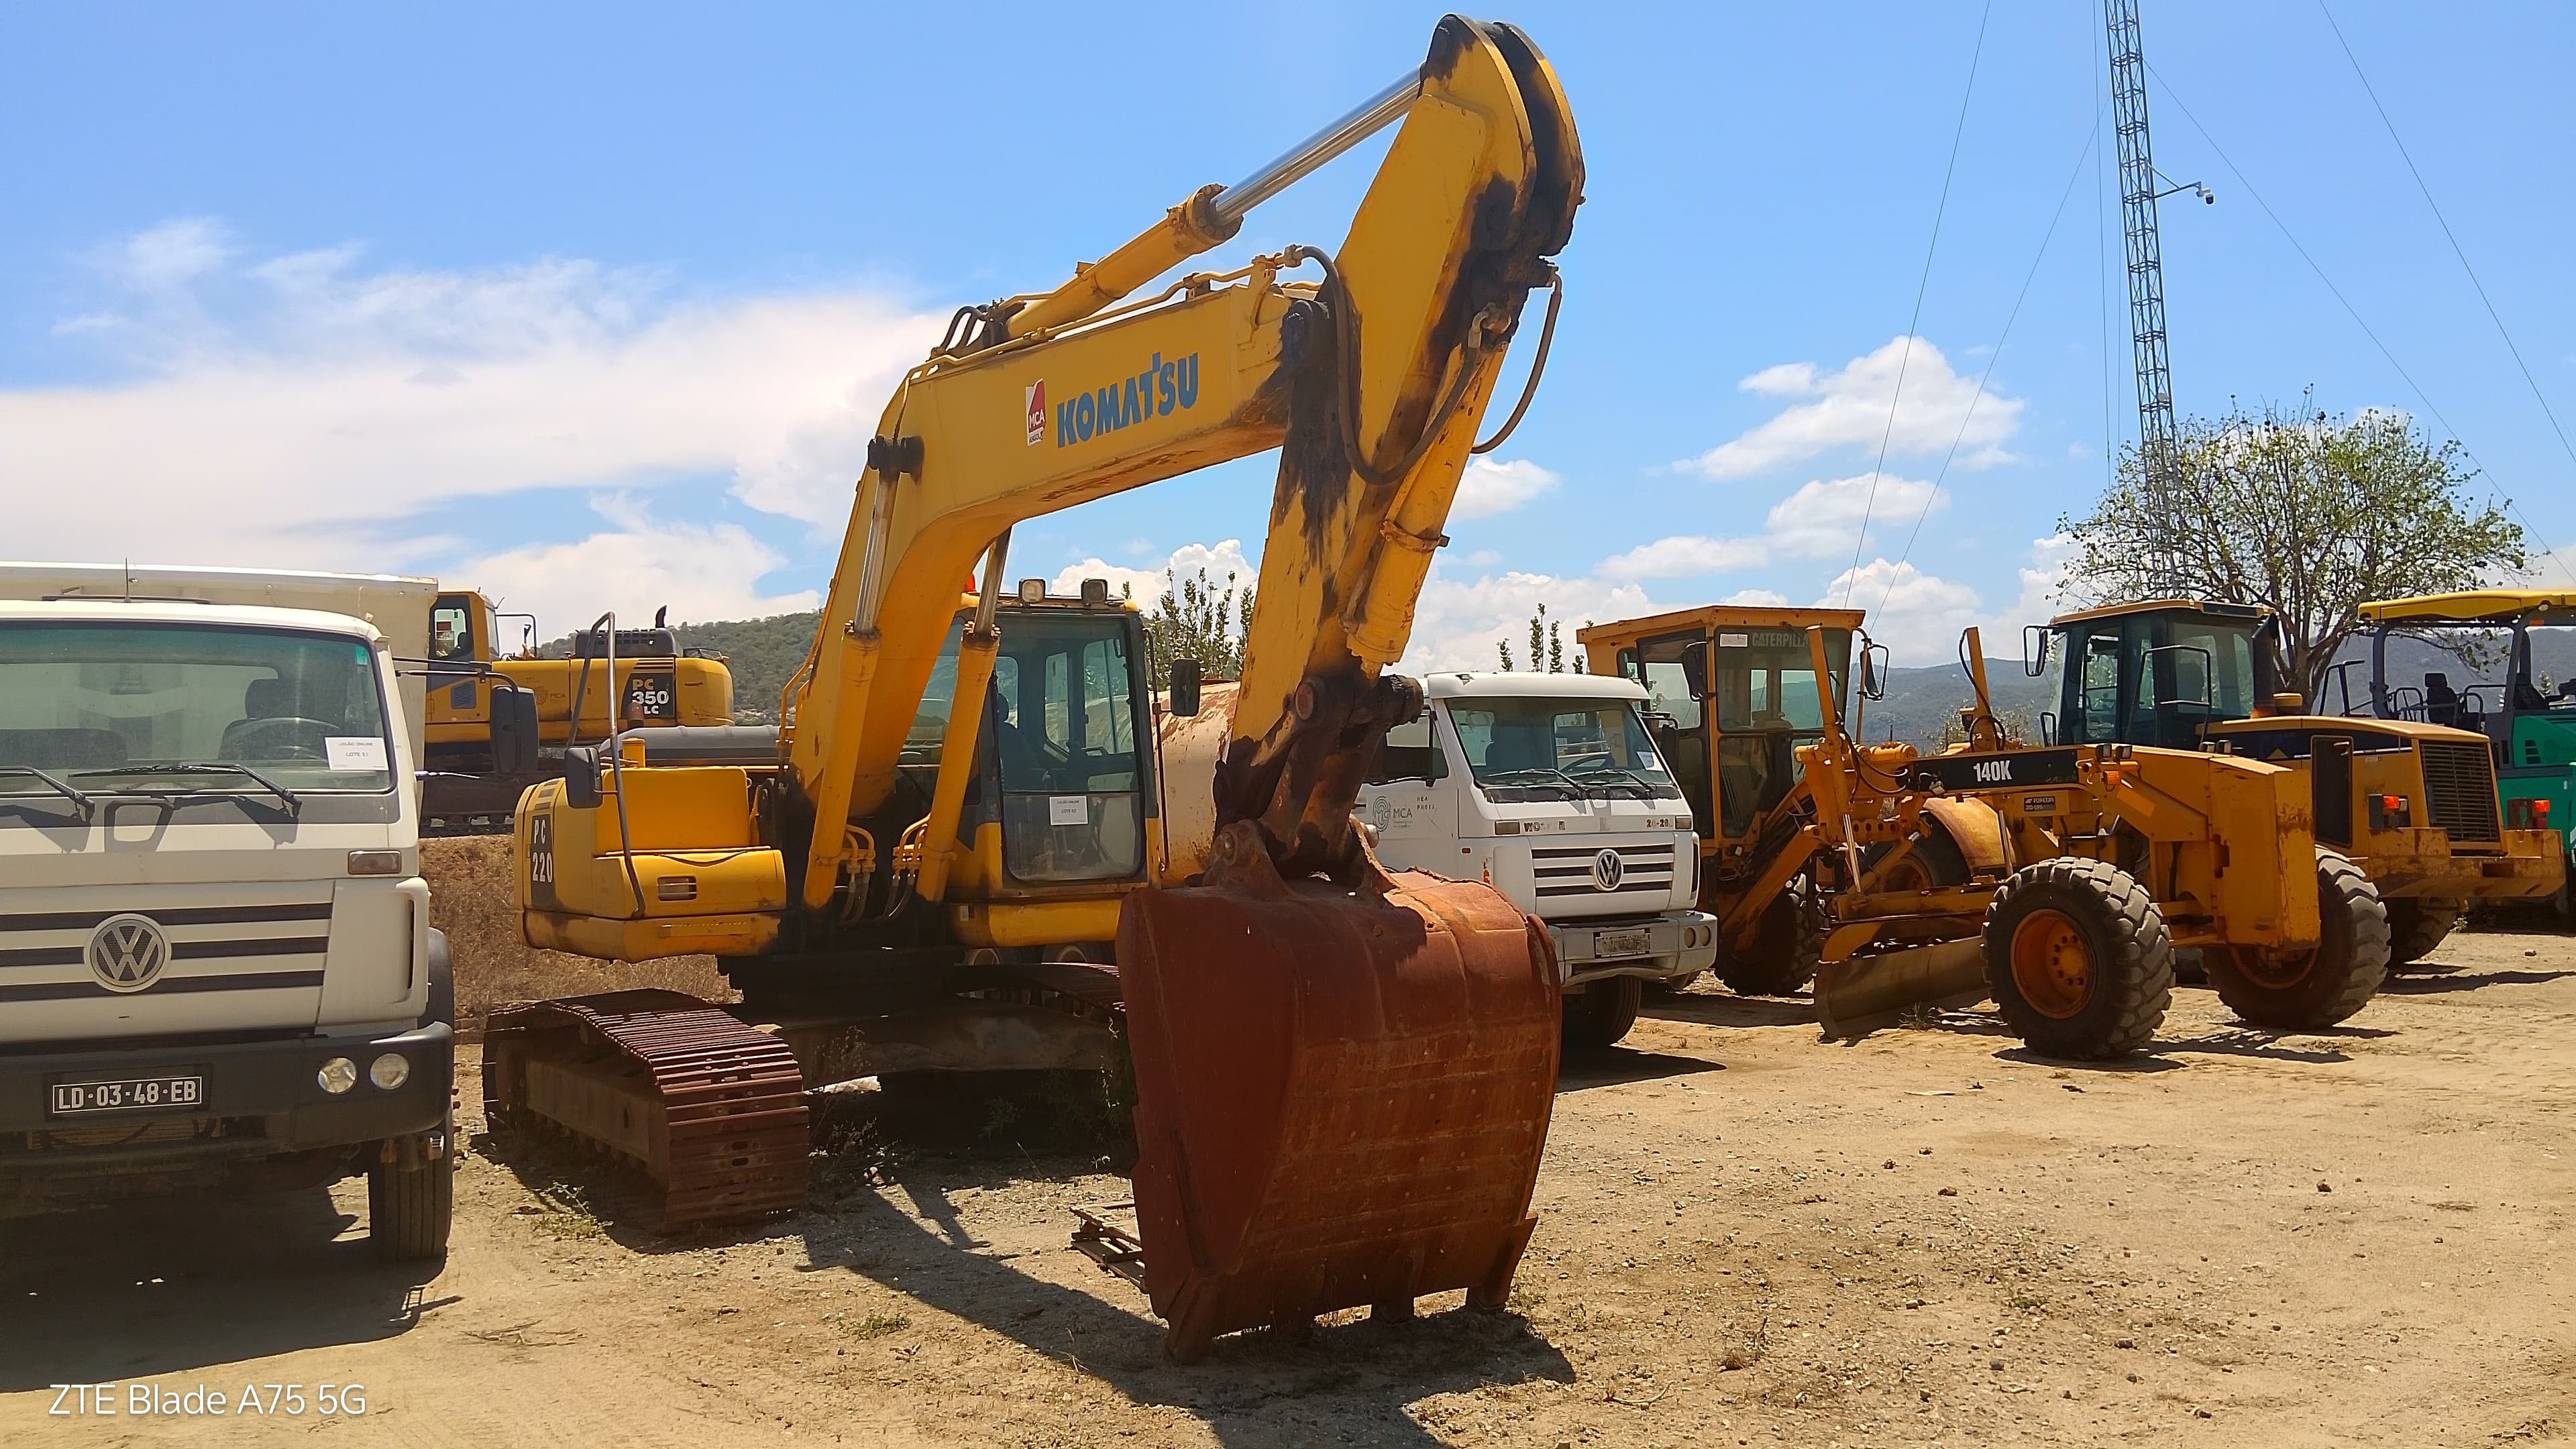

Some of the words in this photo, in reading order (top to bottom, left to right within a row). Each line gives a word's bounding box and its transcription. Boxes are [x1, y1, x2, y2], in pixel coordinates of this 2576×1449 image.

[1057, 352, 1198, 448] KOMATSU
[1030, 409, 1044, 429] MCA
[1753, 633, 1810, 647] CATERPILLA
[633, 679, 654, 690] PC
[632, 691, 669, 705] 350
[643, 706, 659, 714] LC
[1973, 760, 2012, 782] 140K
[1393, 808, 1413, 818] MCA
[534, 819, 546, 844] PC
[533, 852, 553, 883] 220
[1596, 851, 1621, 888] VW
[90, 919, 165, 987] VW
